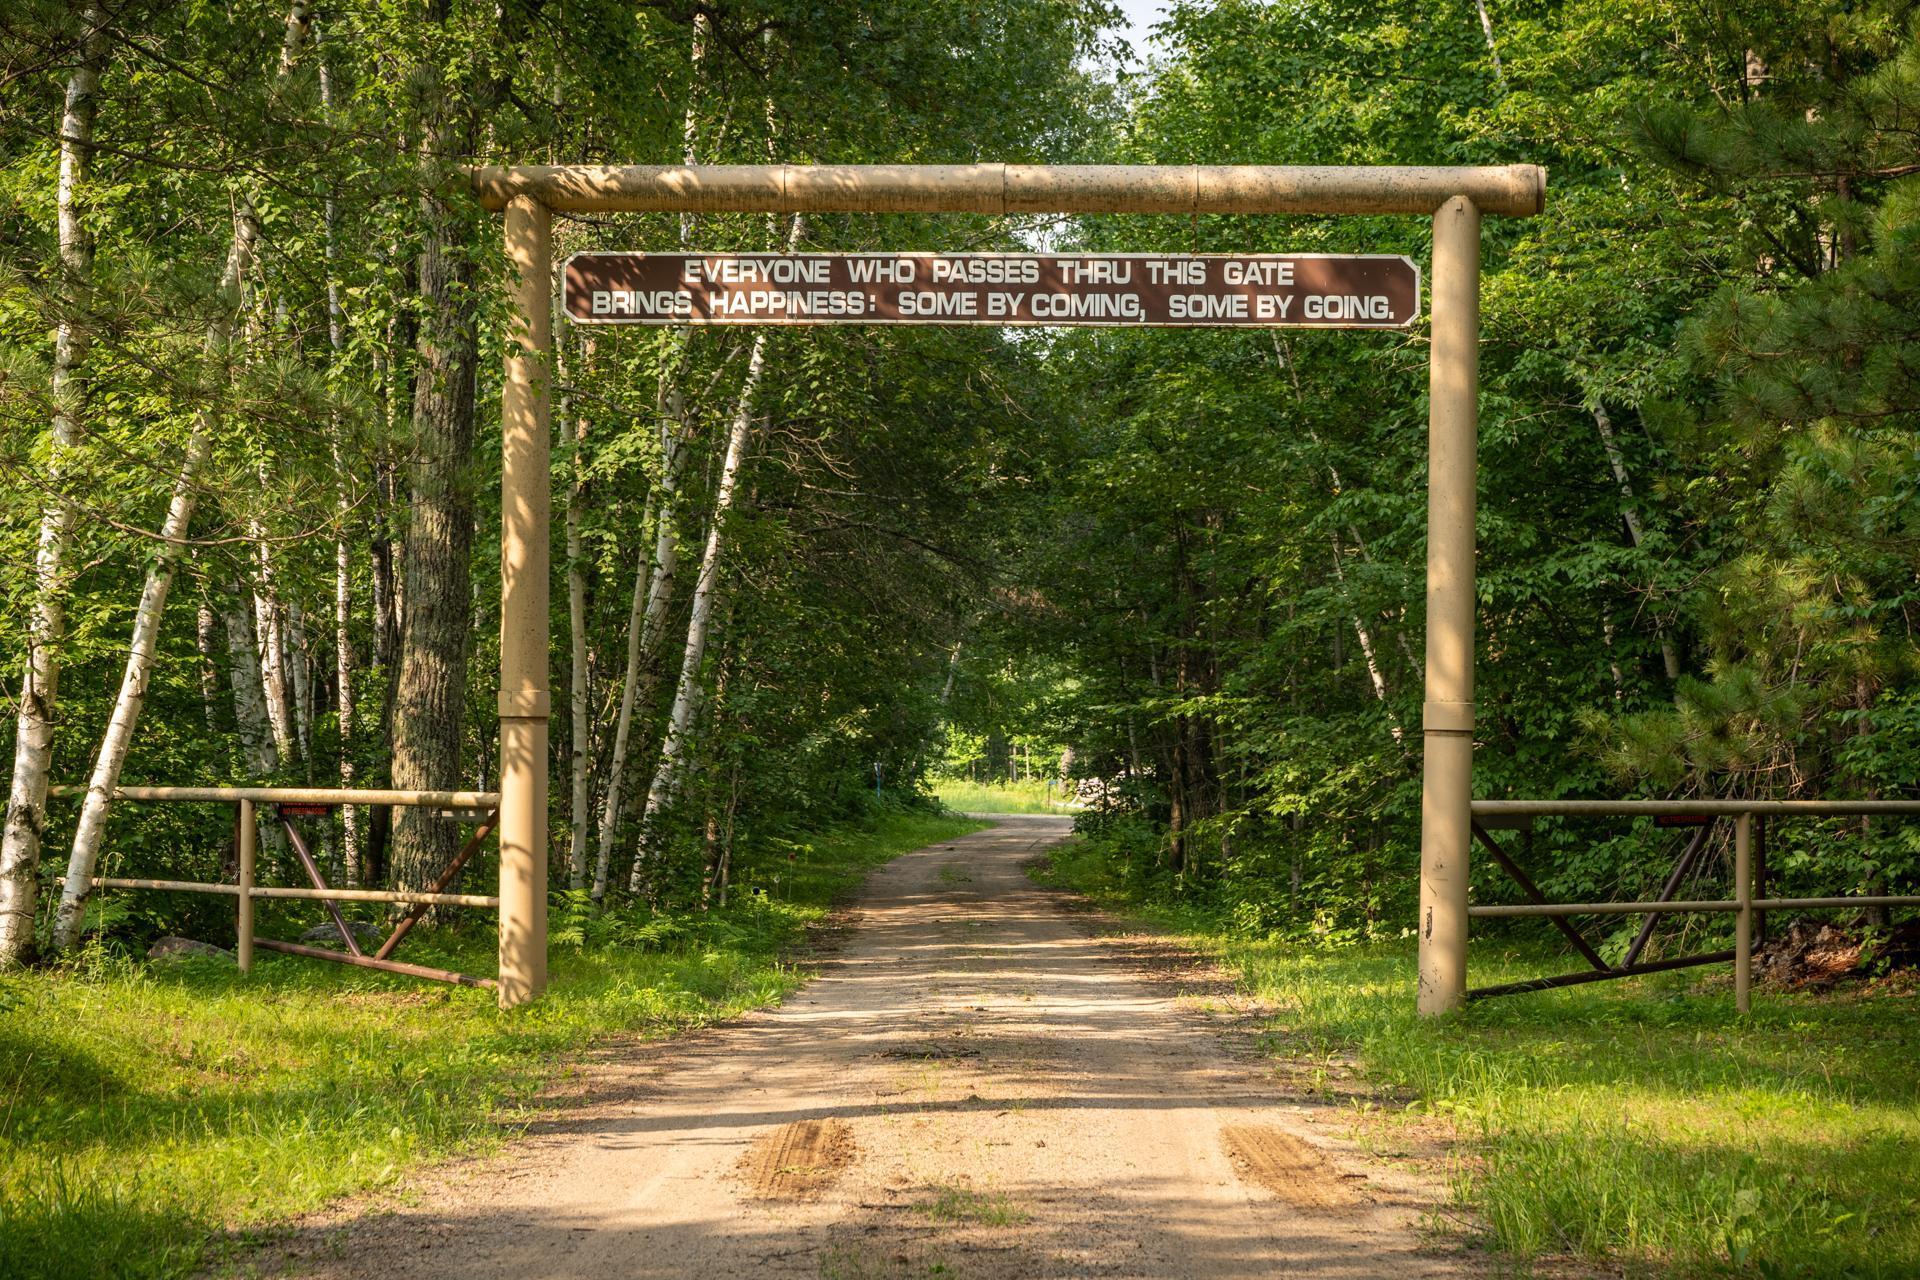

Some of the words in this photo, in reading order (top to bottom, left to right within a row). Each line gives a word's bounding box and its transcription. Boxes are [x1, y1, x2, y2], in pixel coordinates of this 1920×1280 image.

[684, 259, 831, 284] EVERYONE
[847, 259, 915, 284] WHO
[932, 259, 1040, 284] PASSES
[1057, 260, 1131, 285] THRU
[1146, 260, 1206, 285] THIS
[1223, 261, 1294, 286] GATE
[592, 290, 692, 315] BRINGS
[710, 290, 876, 316] HAPPINESS:
[898, 291, 977, 316] SOME
[988, 292, 1025, 317] BY
[1031, 292, 1146, 322] COMING,
[1169, 293, 1248, 318] SOME
[1256, 294, 1293, 319] BY
[1304, 294, 1395, 320] GOING.
